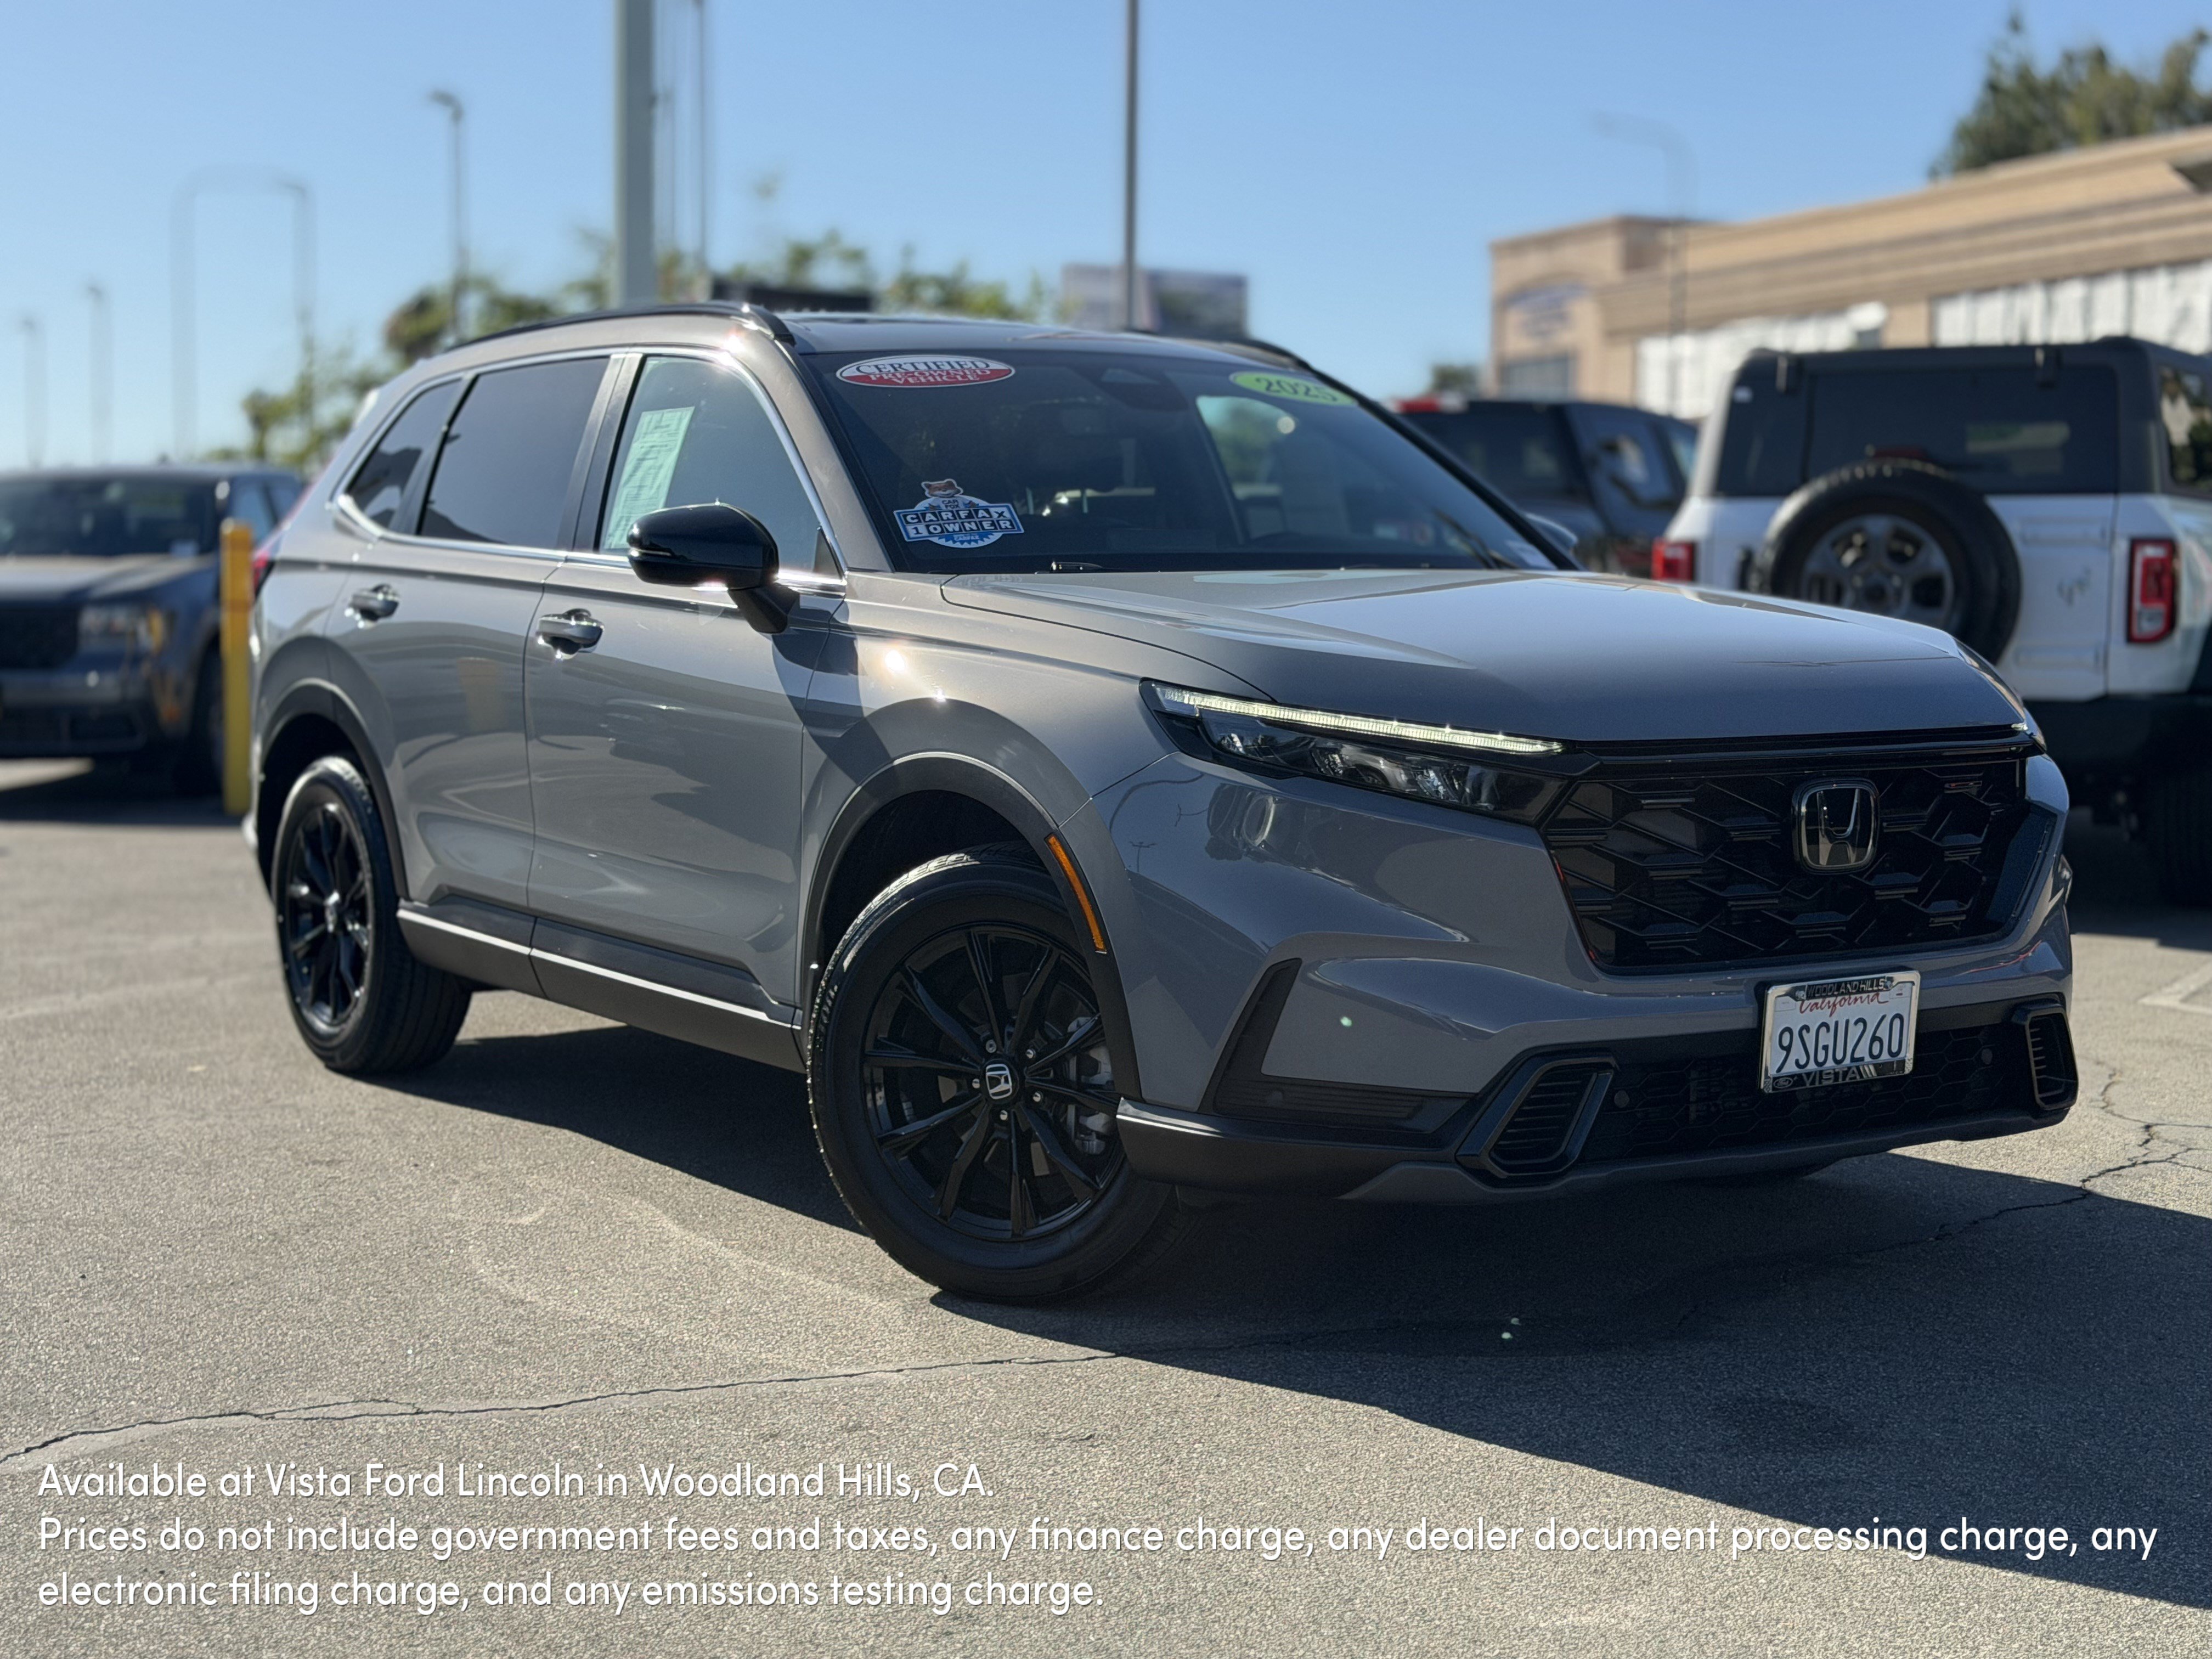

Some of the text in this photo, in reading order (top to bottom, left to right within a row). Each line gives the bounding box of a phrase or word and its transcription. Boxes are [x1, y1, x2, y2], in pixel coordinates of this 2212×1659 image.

[855, 360, 991, 375] CERTIFIED
[870, 369, 991, 380] PRE-OWNED
[890, 375, 980, 384] VEHICLE
[1255, 377, 1338, 402] 2025
[906, 509, 1007, 523] CARFAX
[912, 521, 1012, 535] 1 OWNER
[1808, 981, 1859, 997] WOODLAND
[1860, 979, 1886, 991] HILLS
[1799, 992, 1889, 1018] California
[1776, 1013, 1904, 1074] 9SGU260
[1802, 1067, 1860, 1087] VISTA
